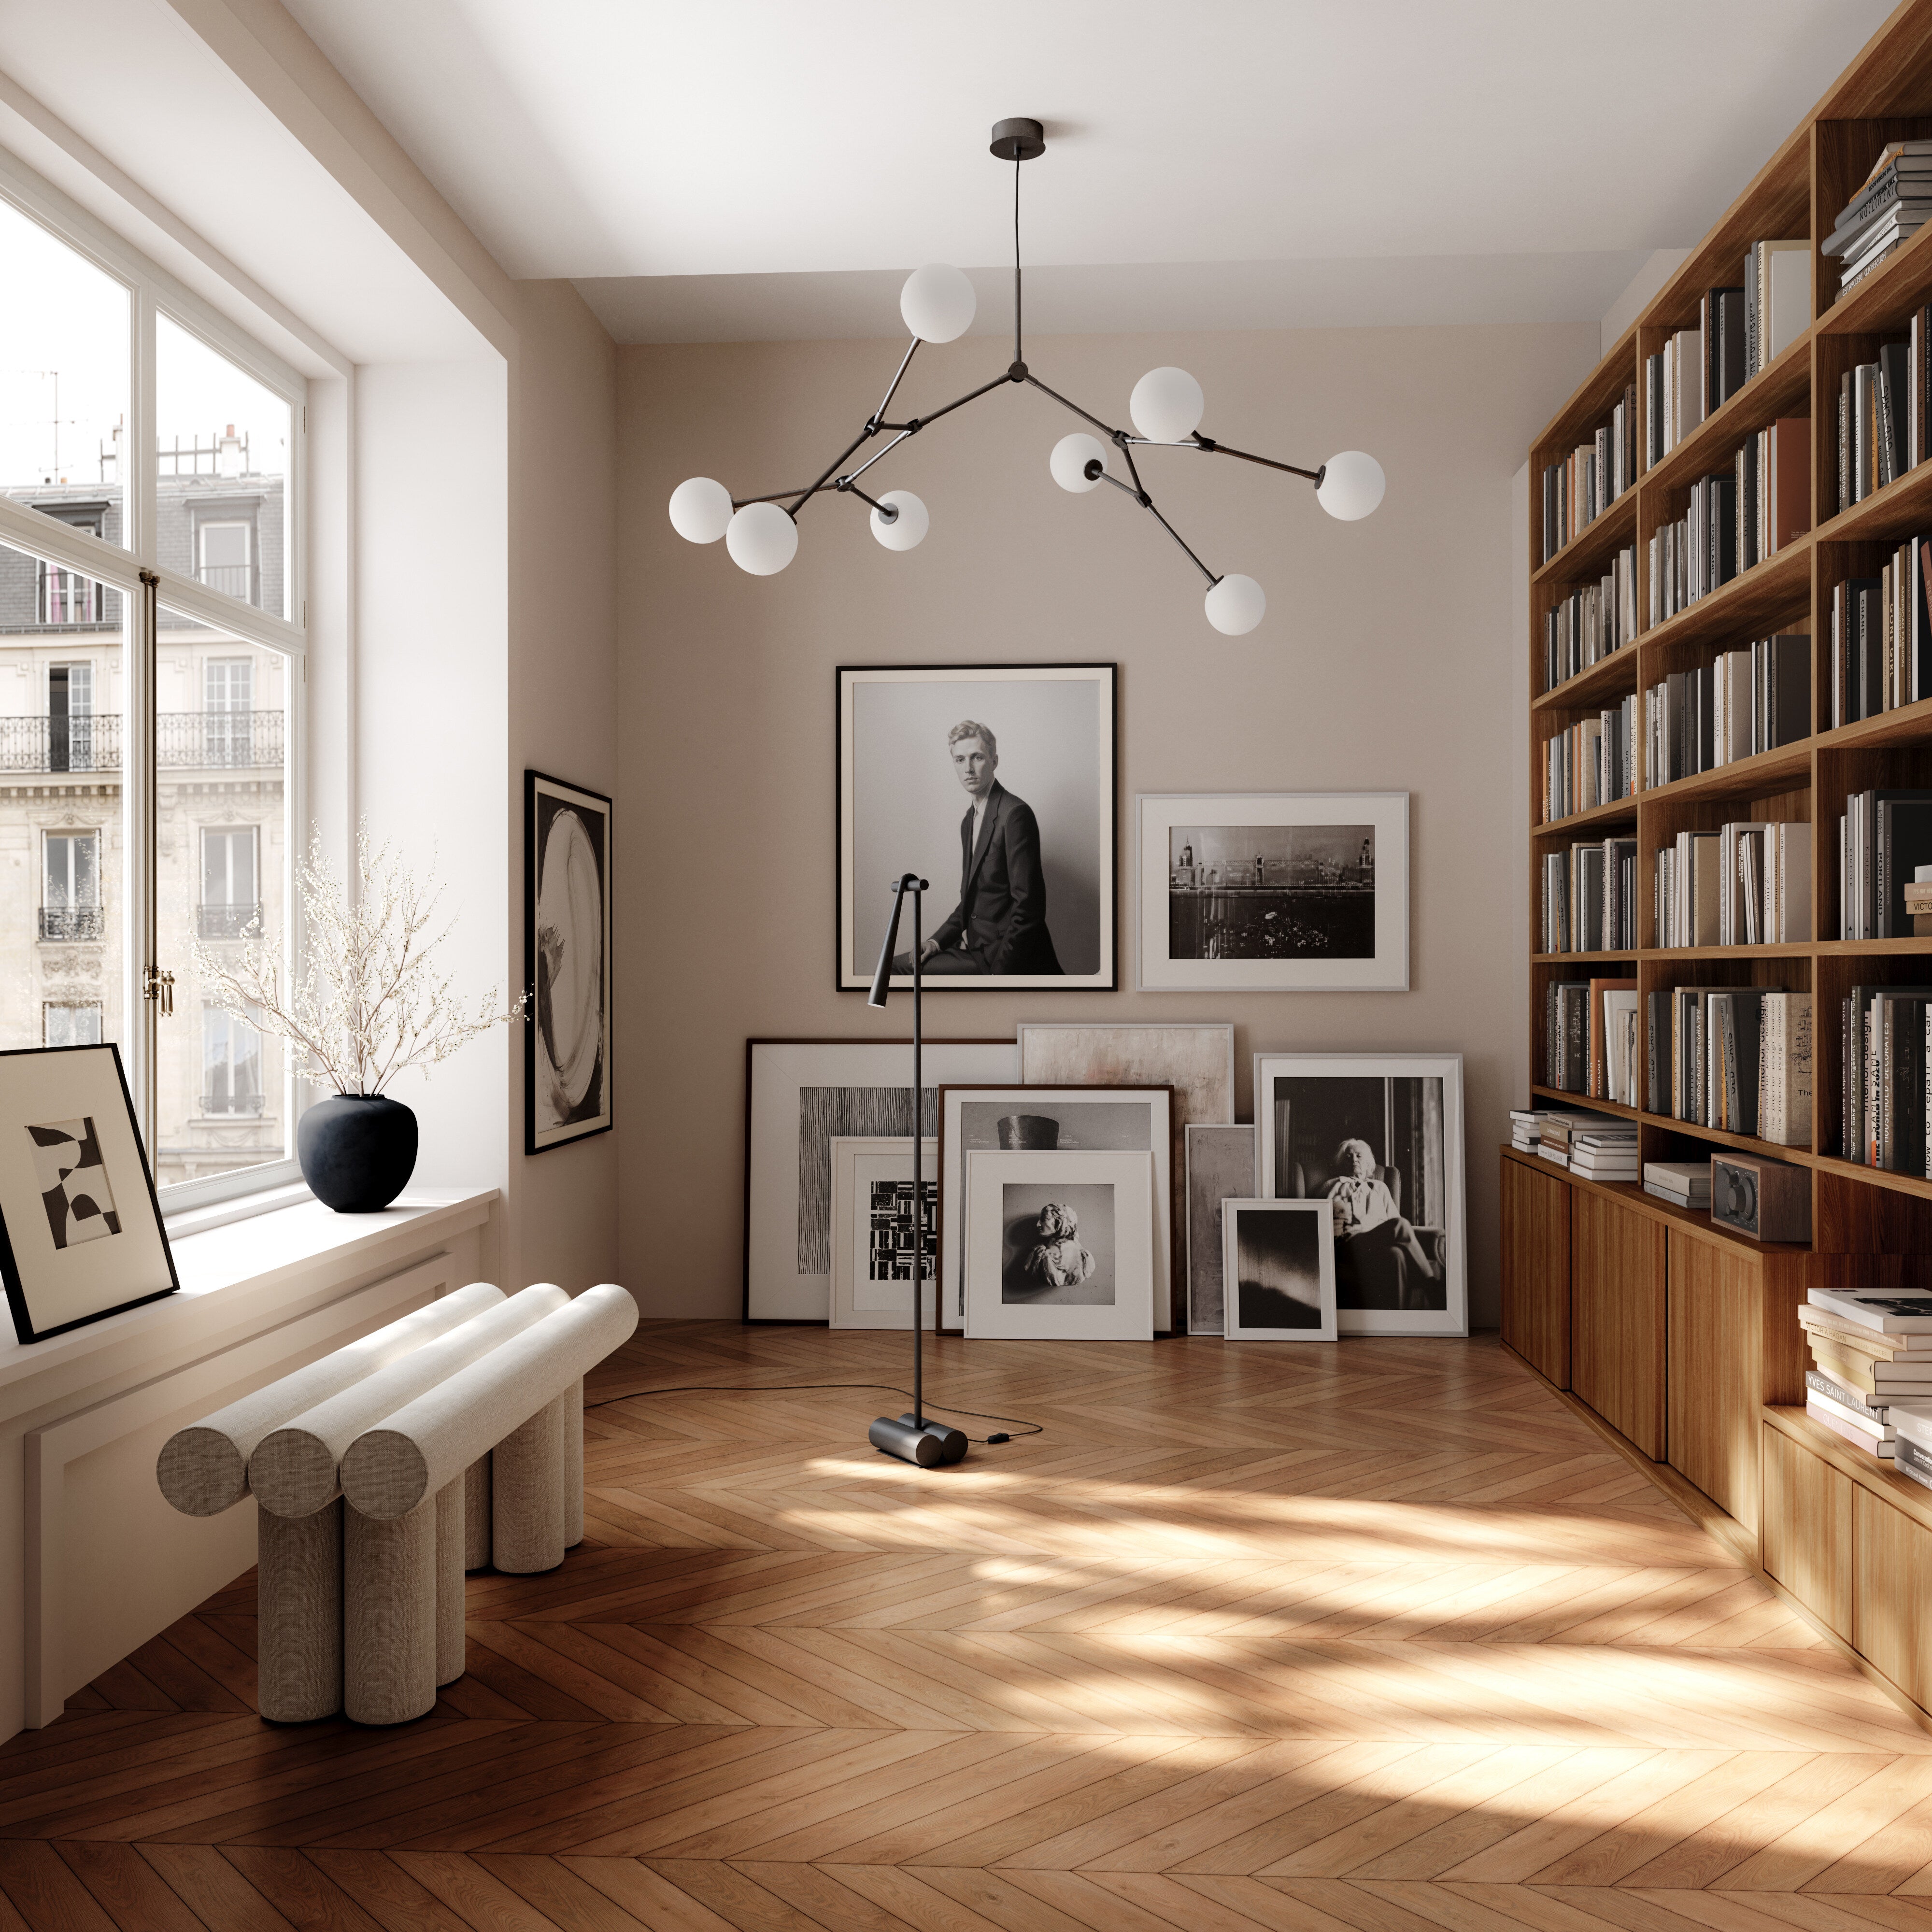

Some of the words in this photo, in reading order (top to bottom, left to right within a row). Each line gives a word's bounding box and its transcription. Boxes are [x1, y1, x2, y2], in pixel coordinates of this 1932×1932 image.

[1876, 170, 1886, 183] DESIGN
[1868, 180, 1876, 192] BOOK
[1860, 186, 1894, 221] INTUITION
[1681, 736, 1685, 744] to
[1851, 1032, 1856, 1041] in
[1851, 1095, 1856, 1104] an
[1876, 1091, 1880, 1101] IN
[1851, 1129, 1856, 1137] to
[1806, 1321, 1828, 1336] VICTORIA
[1829, 1329, 1847, 1343] HAGAN
[1855, 1340, 1870, 1350] DREAM
[1871, 1347, 1887, 1357] SPACES
[1808, 1375, 1824, 1392] YVES
[1826, 1384, 1845, 1402] SAINT
[1847, 1395, 1879, 1420] LAURENT
[1906, 1466, 1918, 1478] Michael
[1918, 1474, 1928, 1484] Innes
